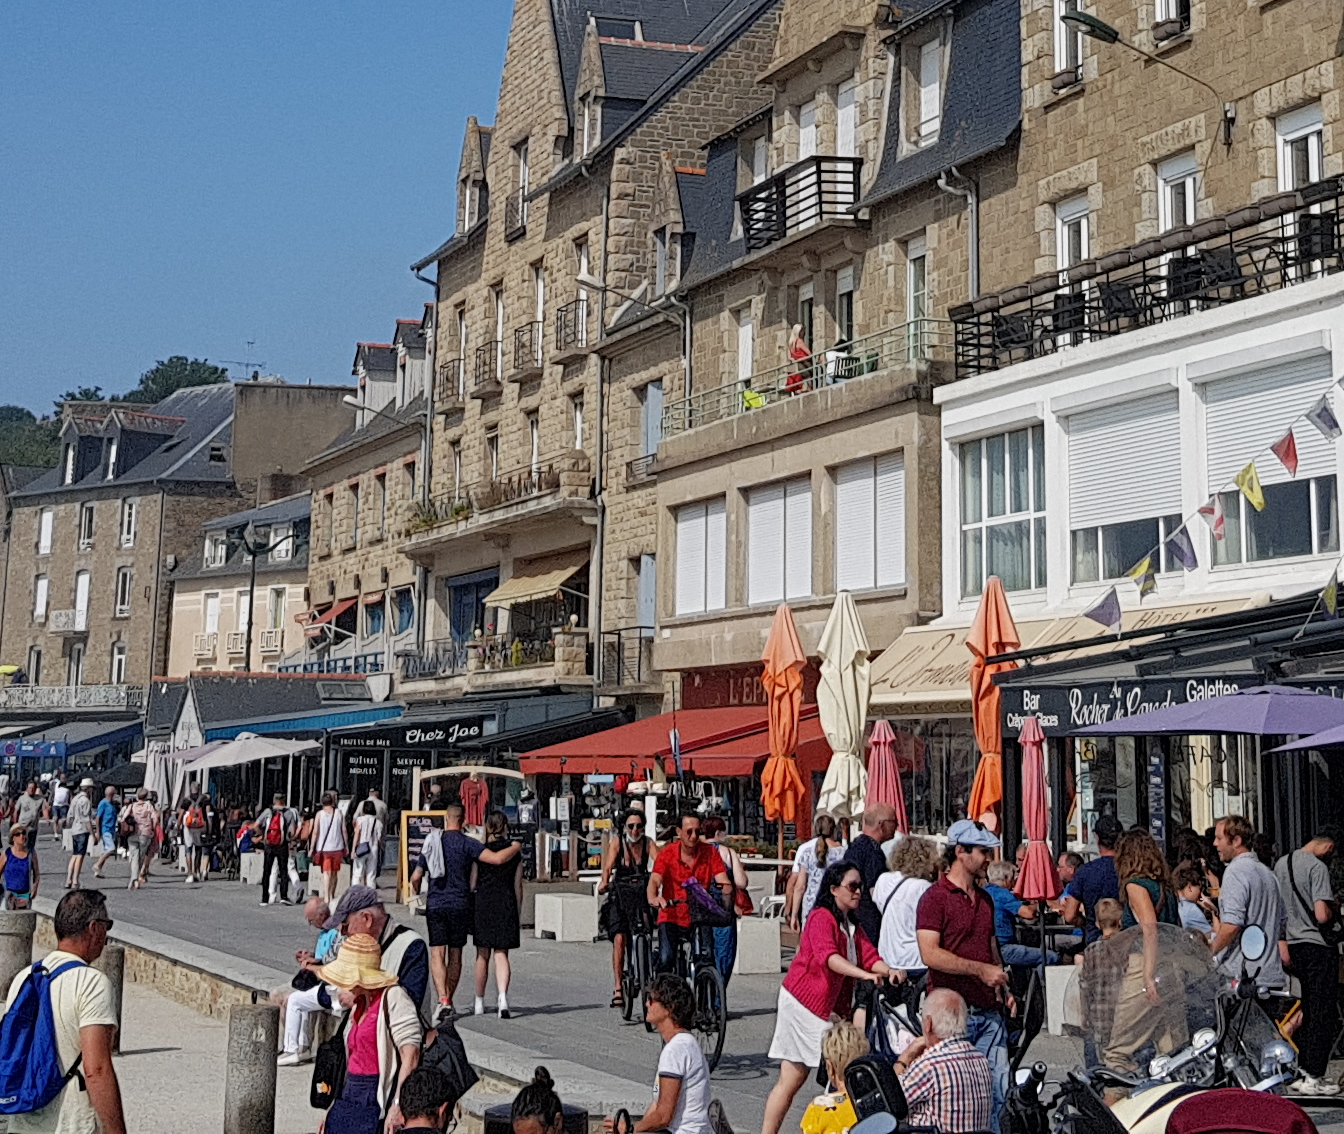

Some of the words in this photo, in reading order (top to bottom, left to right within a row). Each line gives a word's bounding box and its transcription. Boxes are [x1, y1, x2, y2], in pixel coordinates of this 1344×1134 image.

[1023, 689, 1041, 711] Bar
[1068, 688, 1111, 726] Rocher
[406, 728, 446, 744] Chez
[448, 724, 480, 743] Joe
